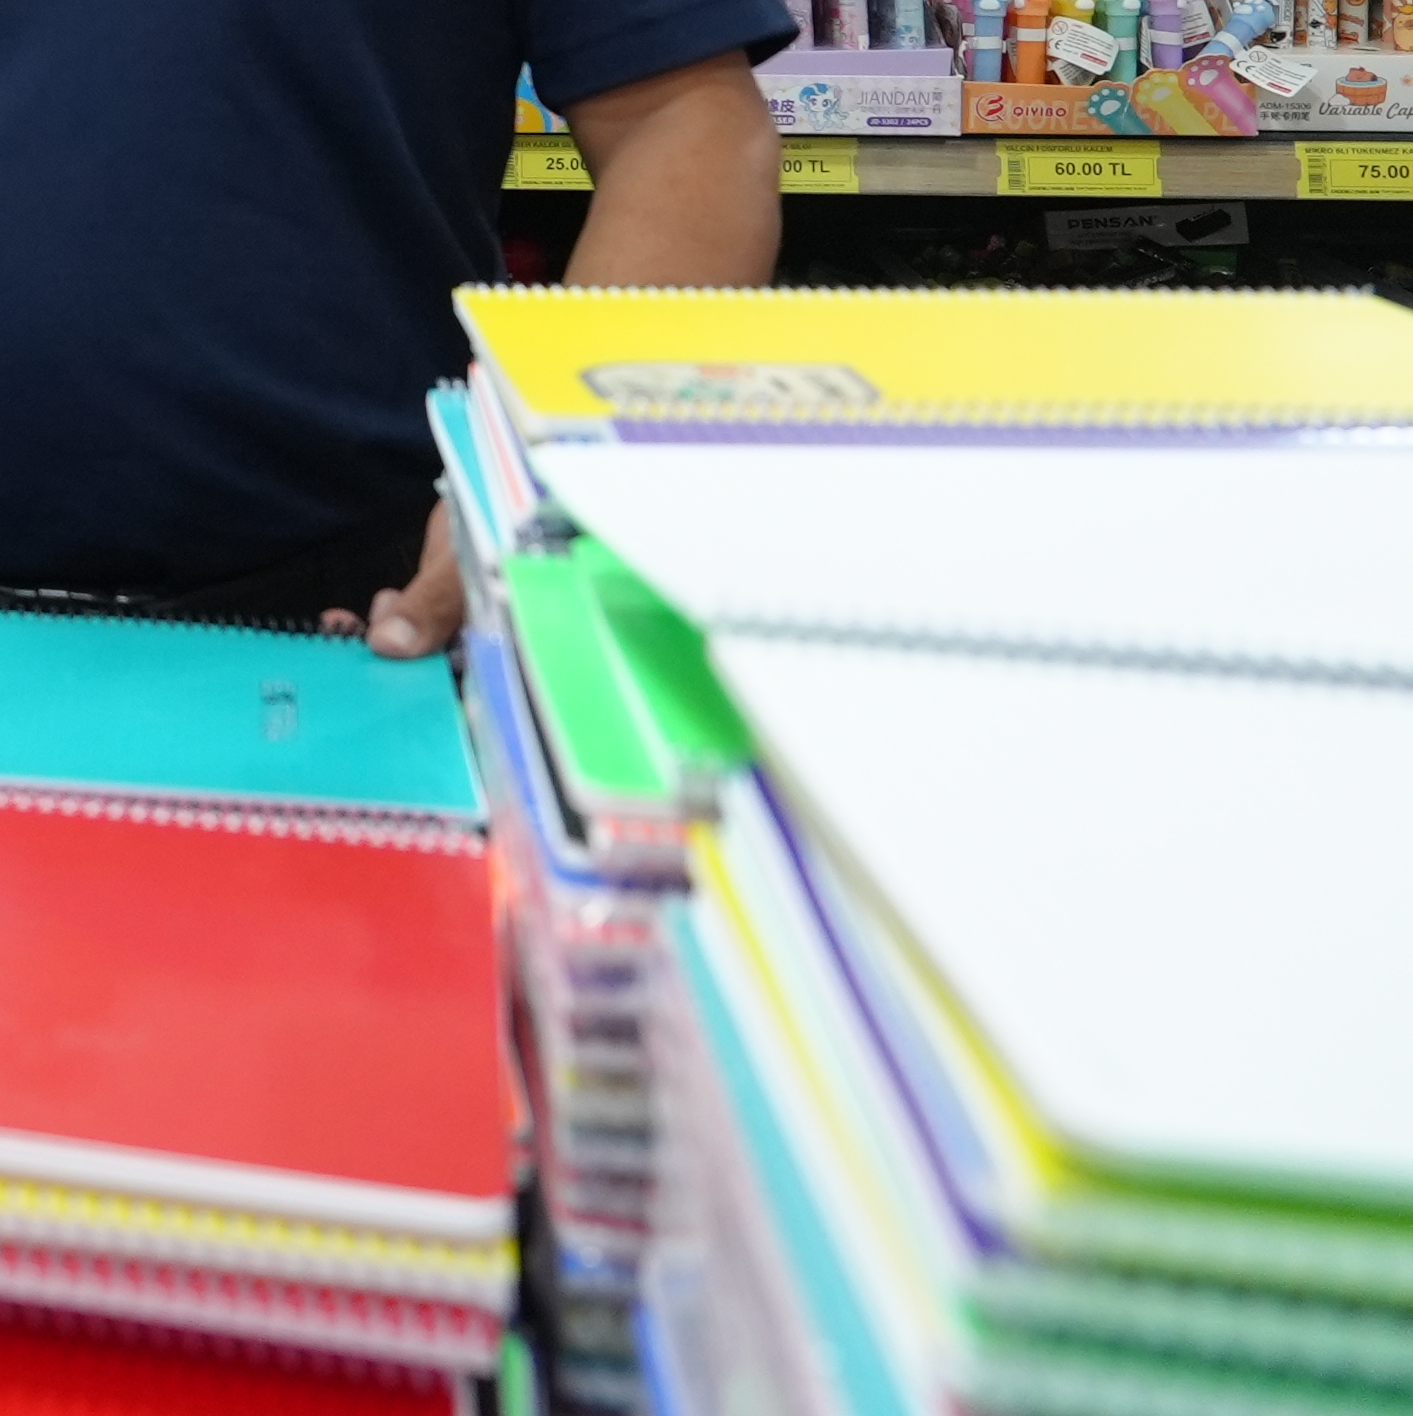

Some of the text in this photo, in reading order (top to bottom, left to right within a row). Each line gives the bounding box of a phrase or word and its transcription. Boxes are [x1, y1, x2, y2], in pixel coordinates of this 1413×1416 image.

[856, 90, 930, 106] JIANDAN
[1012, 104, 1068, 119] QIYIBO
[1318, 102, 1383, 117] Variable
[807, 158, 830, 174] TL
[1054, 162, 1133, 177] 60.00 TL
[1358, 164, 1410, 179] 75.00
